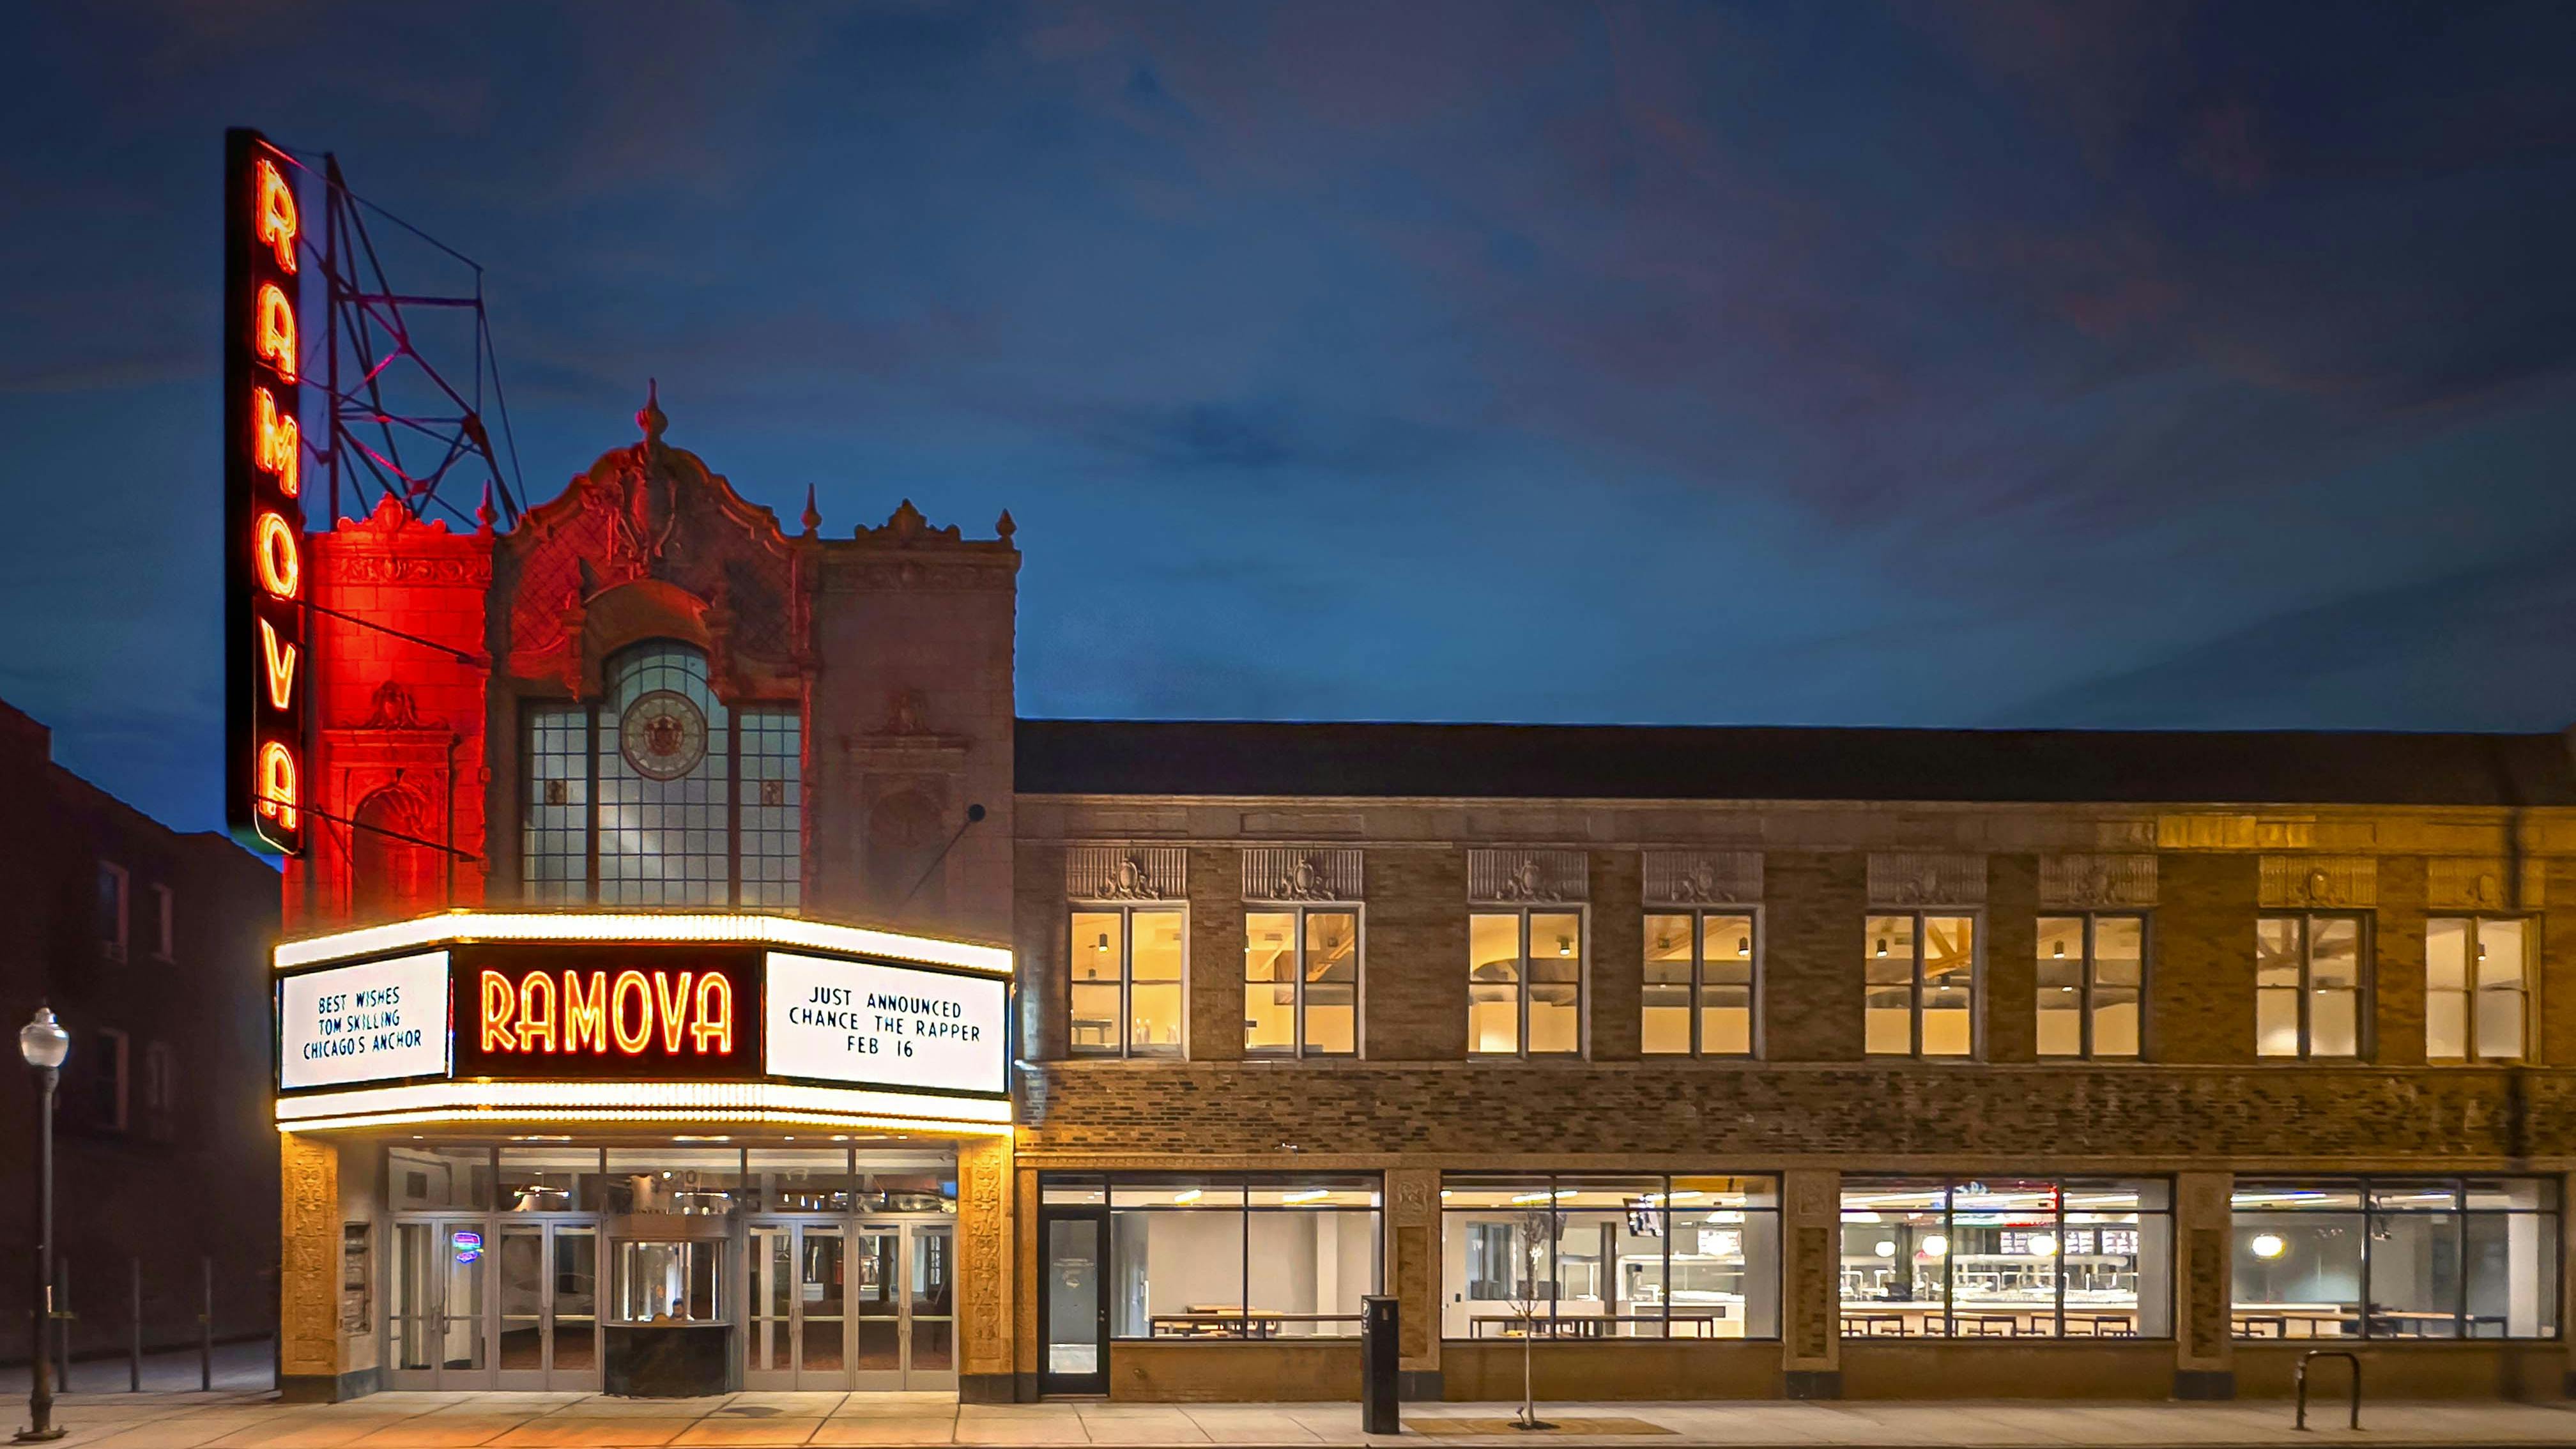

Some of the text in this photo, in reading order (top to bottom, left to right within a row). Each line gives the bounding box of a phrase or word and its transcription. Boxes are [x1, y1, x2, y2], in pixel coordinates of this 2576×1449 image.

[256, 158, 299, 832] RAMOVA
[318, 986, 400, 1015] BEST WISHES
[482, 969, 732, 1054] RAMOVA
[809, 986, 962, 1018] JUST ANNOUNCED
[318, 1009, 400, 1036] TOM SKILLING
[789, 1006, 980, 1043] CHANCE THE RAPPER
[372, 1029, 421, 1052] ANCHOR
[847, 1035, 914, 1058] FEB 16
